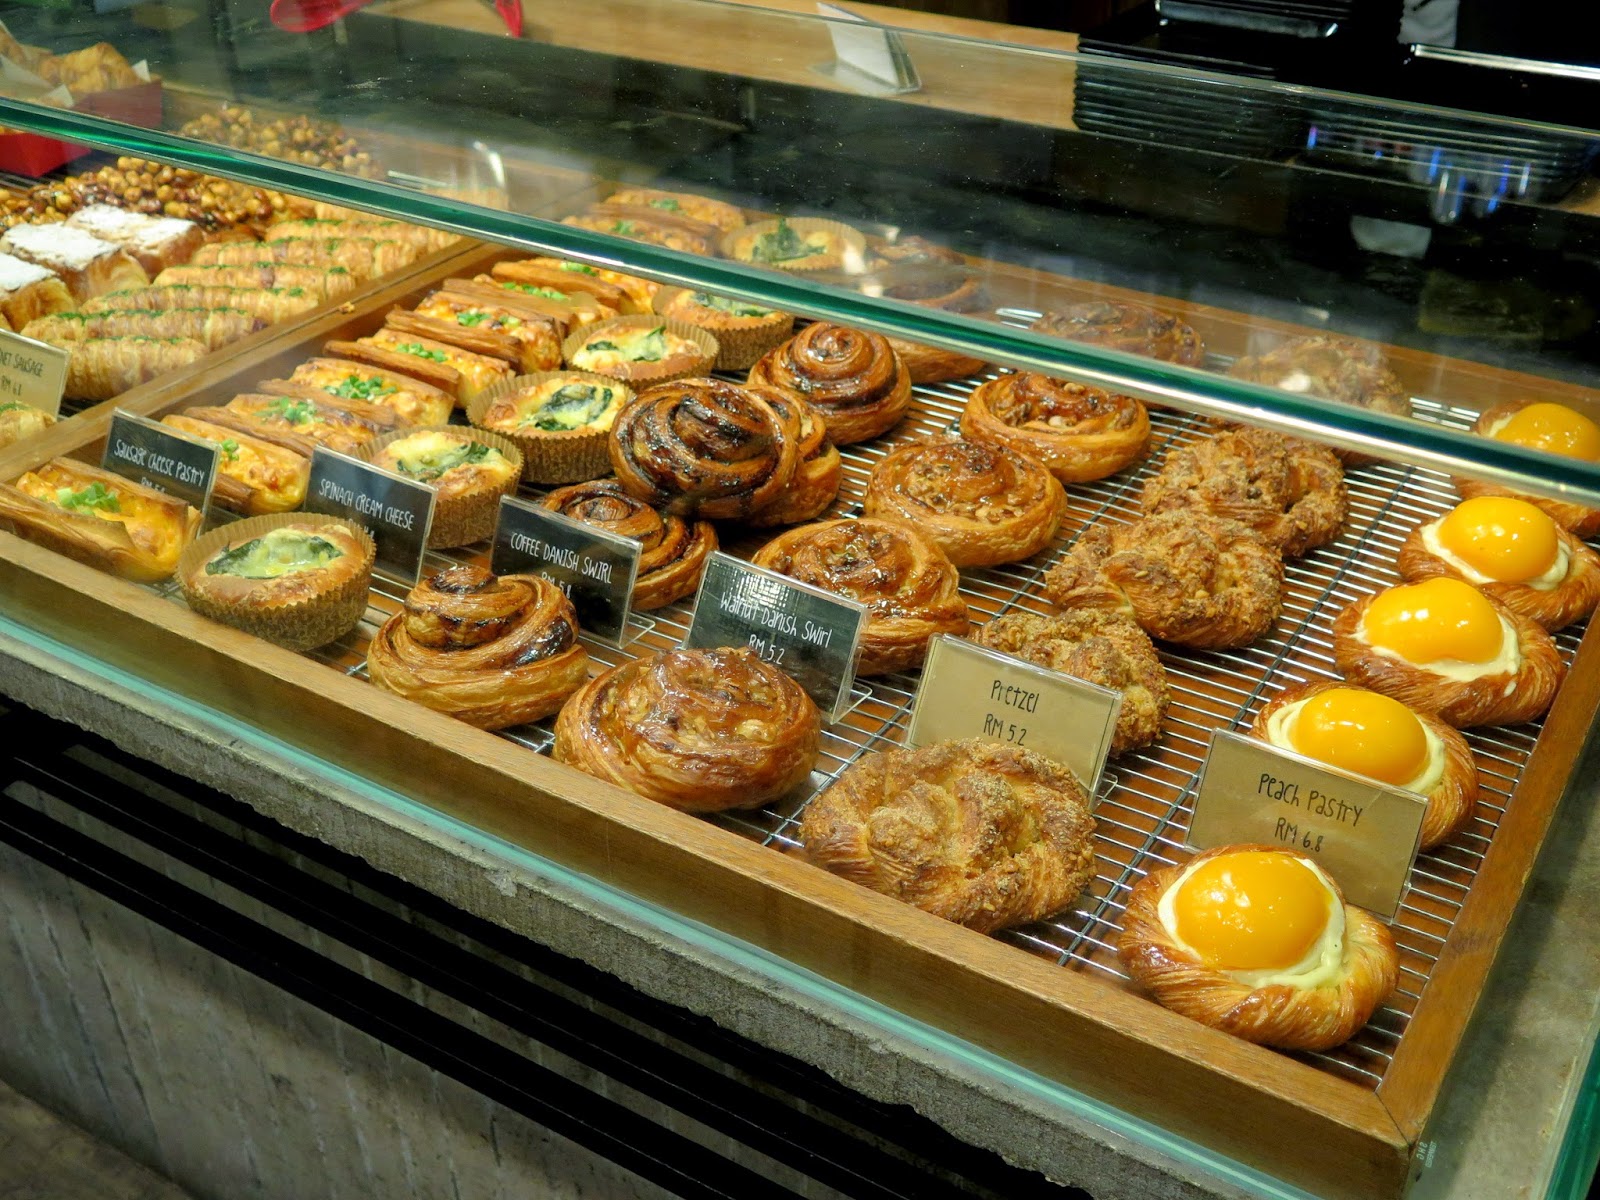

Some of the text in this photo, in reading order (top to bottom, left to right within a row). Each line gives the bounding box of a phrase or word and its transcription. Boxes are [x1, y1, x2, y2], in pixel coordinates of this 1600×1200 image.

[318, 478, 354, 507] SPINACH
[355, 493, 383, 519] CREAM
[385, 506, 415, 531] CHEESE
[510, 532, 613, 584] COFFEE DANISH SWIRL
[761, 607, 798, 637] Danish
[801, 620, 833, 649] Swirl
[749, 633, 785, 665] RM 5.2
[990, 679, 1040, 714] Pretzel
[983, 713, 1027, 747] RM 5.2
[1258, 773, 1364, 827] Peach Pastry
[1274, 817, 1324, 852] RM 6.8
